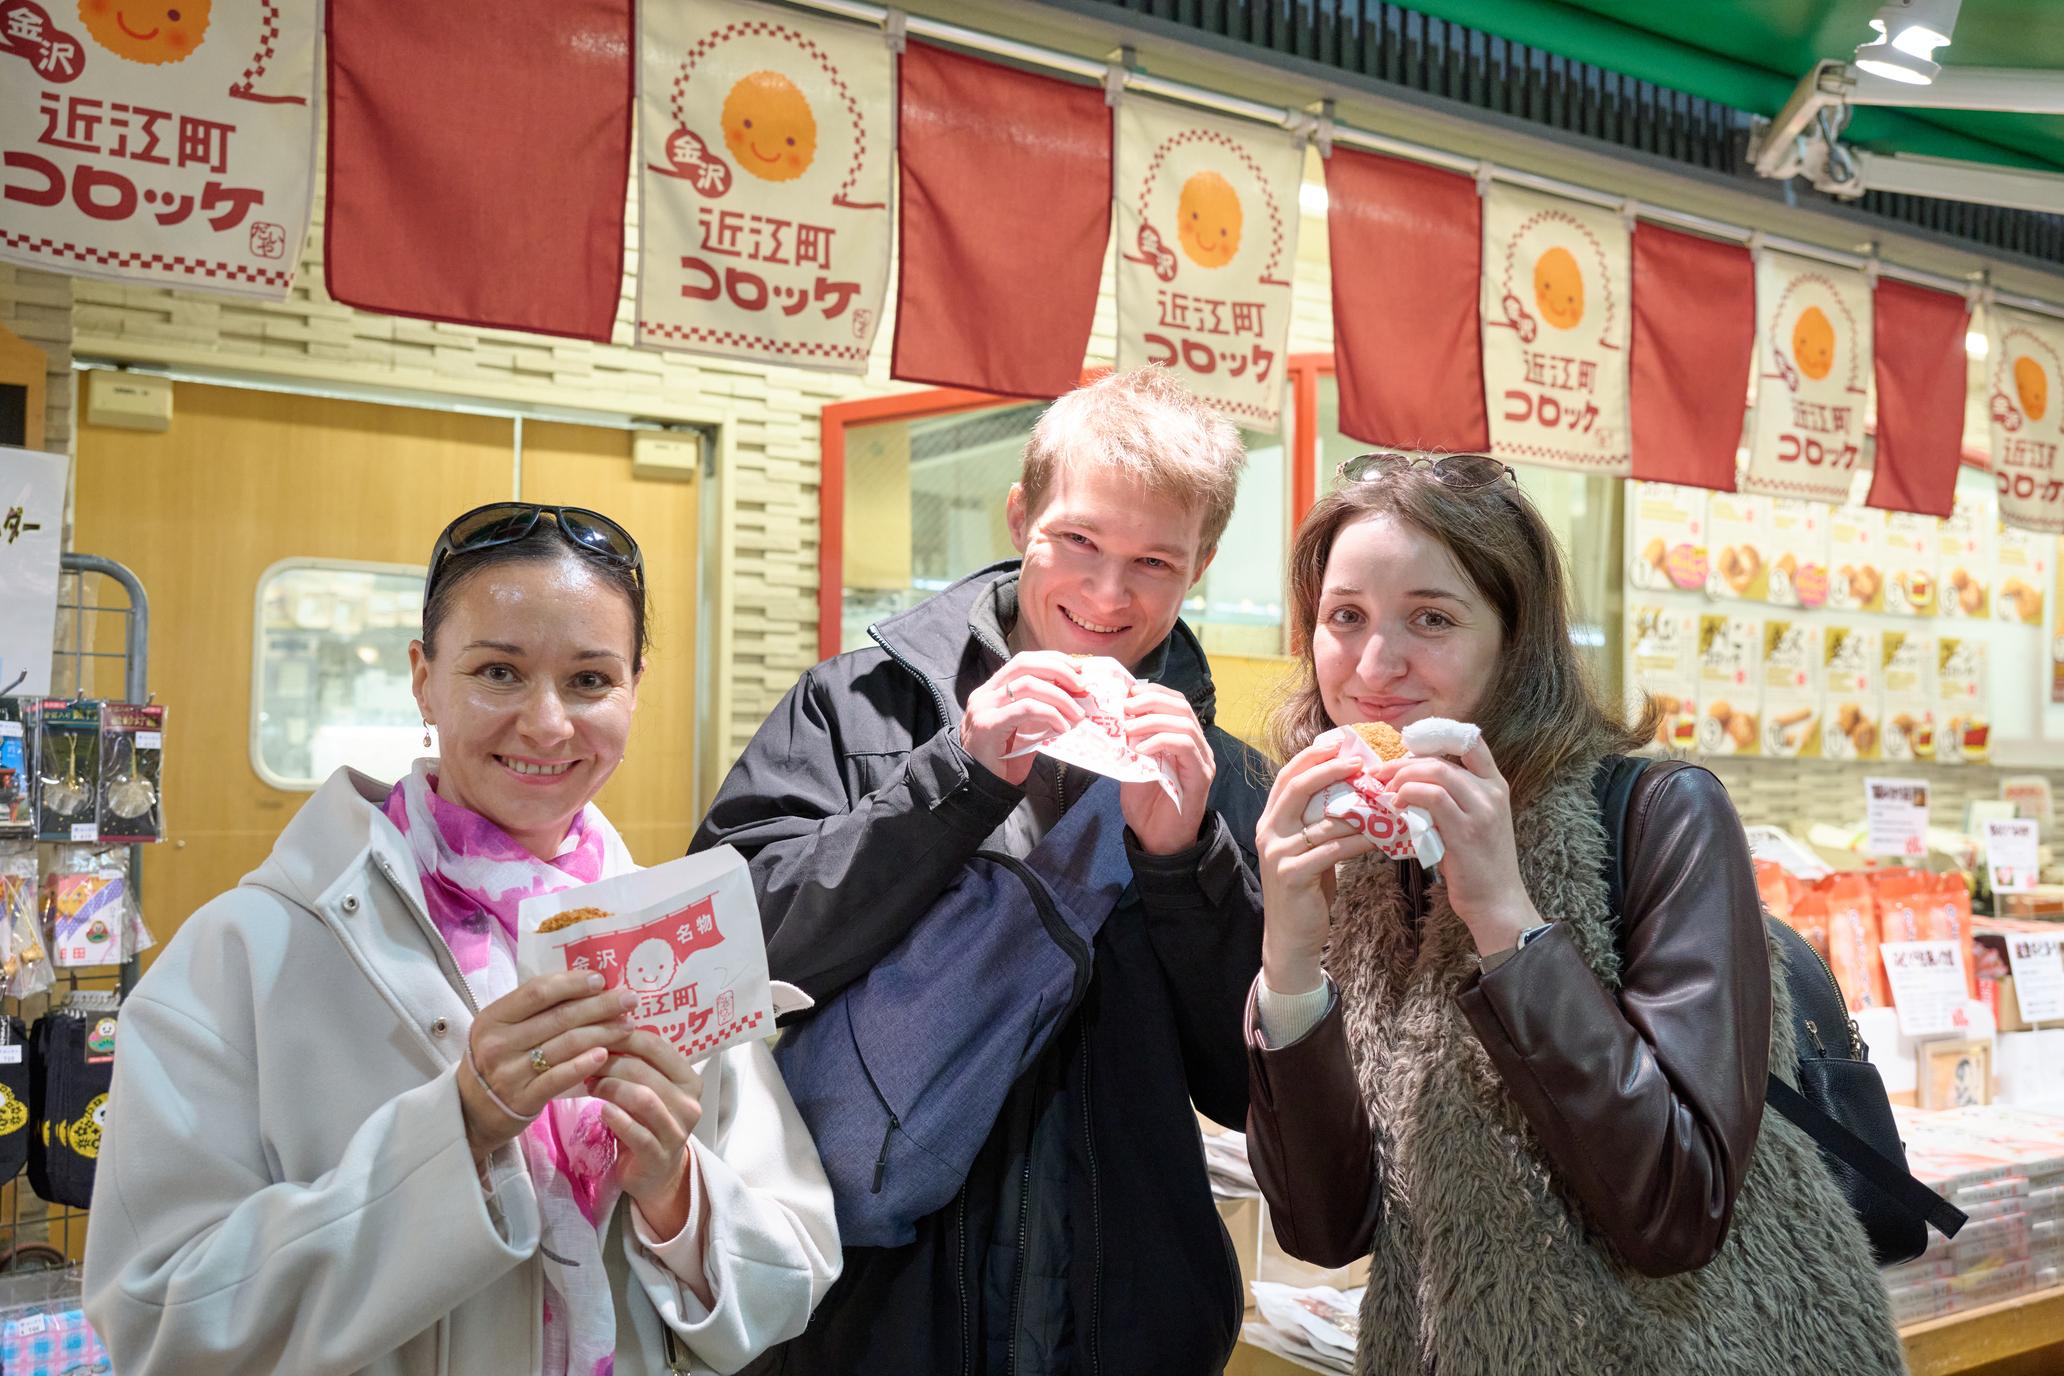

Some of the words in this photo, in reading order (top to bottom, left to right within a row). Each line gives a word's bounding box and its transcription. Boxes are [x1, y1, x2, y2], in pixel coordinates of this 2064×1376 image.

[7, 6, 75, 75] 金沢
[37, 91, 236, 174] 近江町
[672, 134, 725, 192] 金沢
[3, 151, 265, 232] コロッケ
[698, 207, 836, 270] 近江町
[680, 256, 861, 320] コロッケ
[1157, 290, 1266, 338] 近江町
[1144, 333, 1274, 383] コロッケ
[1523, 350, 1597, 394] 近江町
[1504, 389, 1599, 433] コロッケ
[0, 506, 40, 543] ダー
[571, 949, 618, 970] 金沢
[675, 914, 713, 944] 名物
[621, 982, 698, 1020] 江町
[635, 1007, 713, 1043] ッケ
